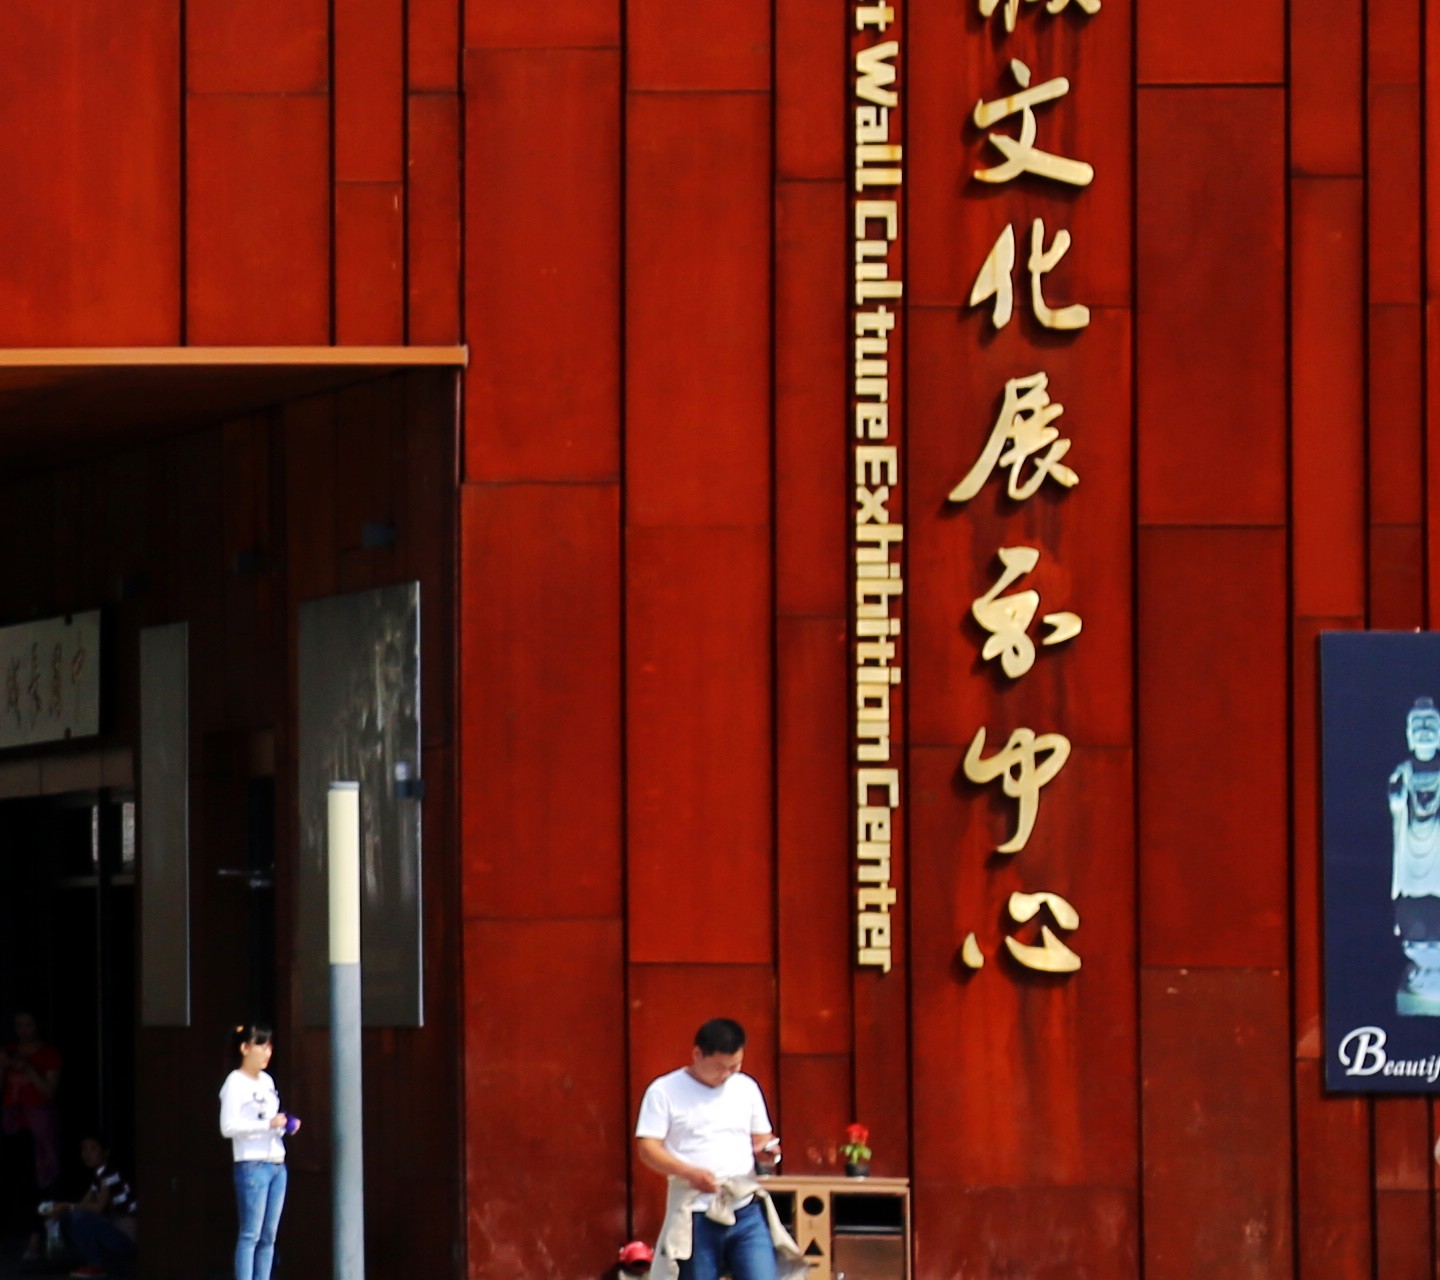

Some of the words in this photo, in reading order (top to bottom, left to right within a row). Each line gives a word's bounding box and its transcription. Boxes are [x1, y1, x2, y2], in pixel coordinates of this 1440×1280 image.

[855, 40, 904, 192] Wall
[855, 200, 904, 439] Culture
[855, 444, 904, 762] Exhibition
[856, 767, 900, 973] Center
